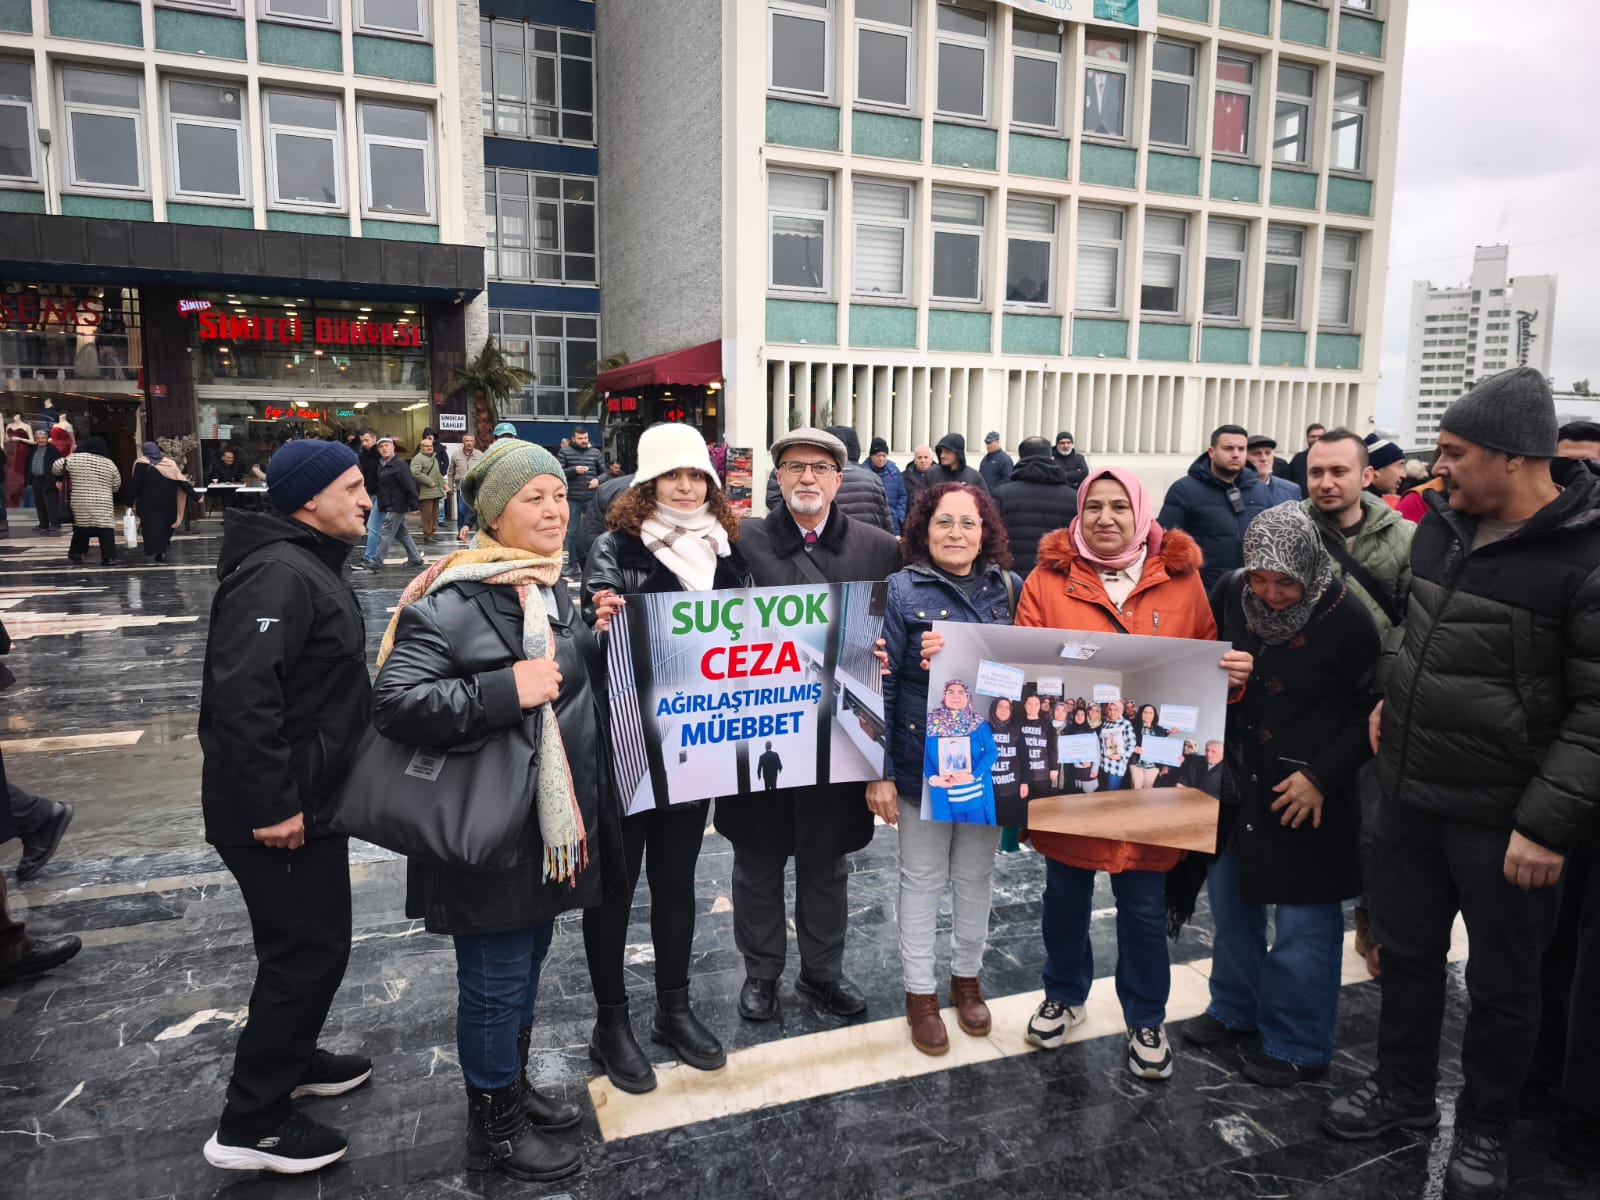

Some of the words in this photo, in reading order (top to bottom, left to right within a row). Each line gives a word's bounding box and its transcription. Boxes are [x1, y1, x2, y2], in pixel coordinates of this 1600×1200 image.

[671, 597, 744, 641] SUÇ
[753, 592, 829, 628] YOK
[700, 641, 801, 681] CEZA
[656, 682, 822, 717] AĞIRLAŞTIRILMIŞ
[681, 711, 804, 747] MÜEBBET
